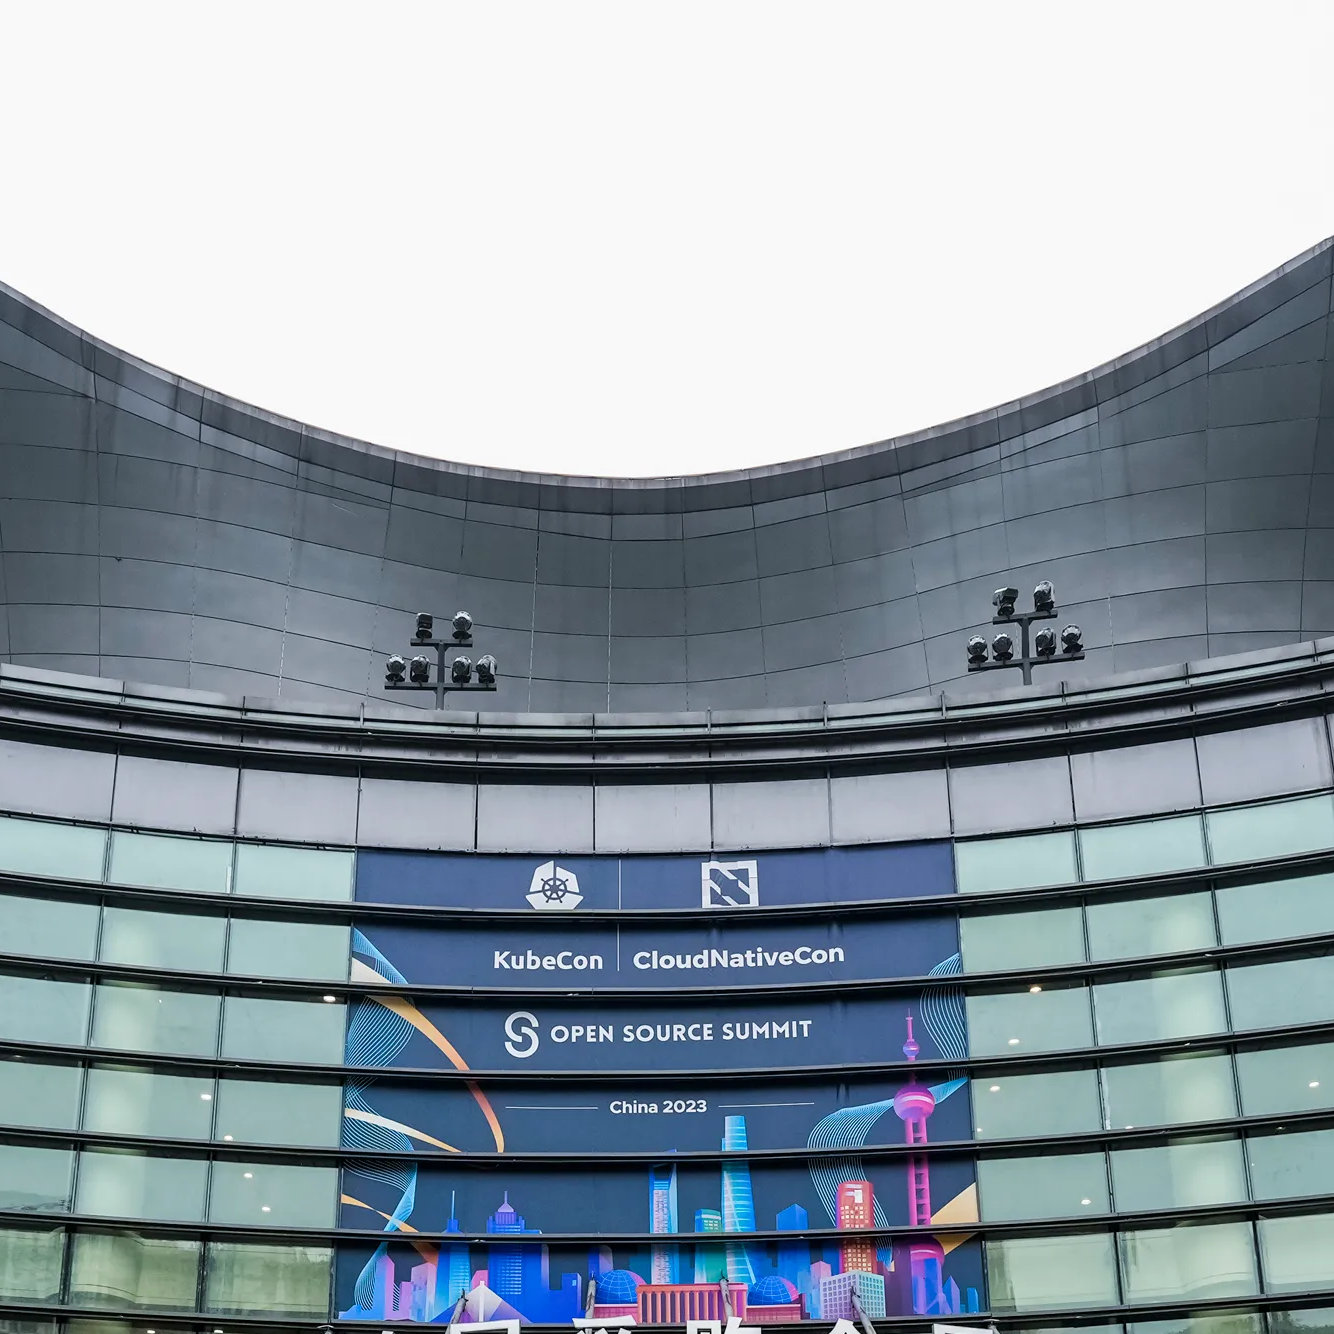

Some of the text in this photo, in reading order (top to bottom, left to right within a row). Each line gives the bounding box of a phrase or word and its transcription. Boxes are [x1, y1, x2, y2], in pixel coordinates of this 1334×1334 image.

[493, 945, 845, 971] KubeCon CloudNativeCon
[550, 1025, 614, 1043] OPEN
[623, 1023, 714, 1042] SOURCE
[722, 1020, 812, 1040] SUMMIT
[609, 1099, 708, 1115] China 2023
